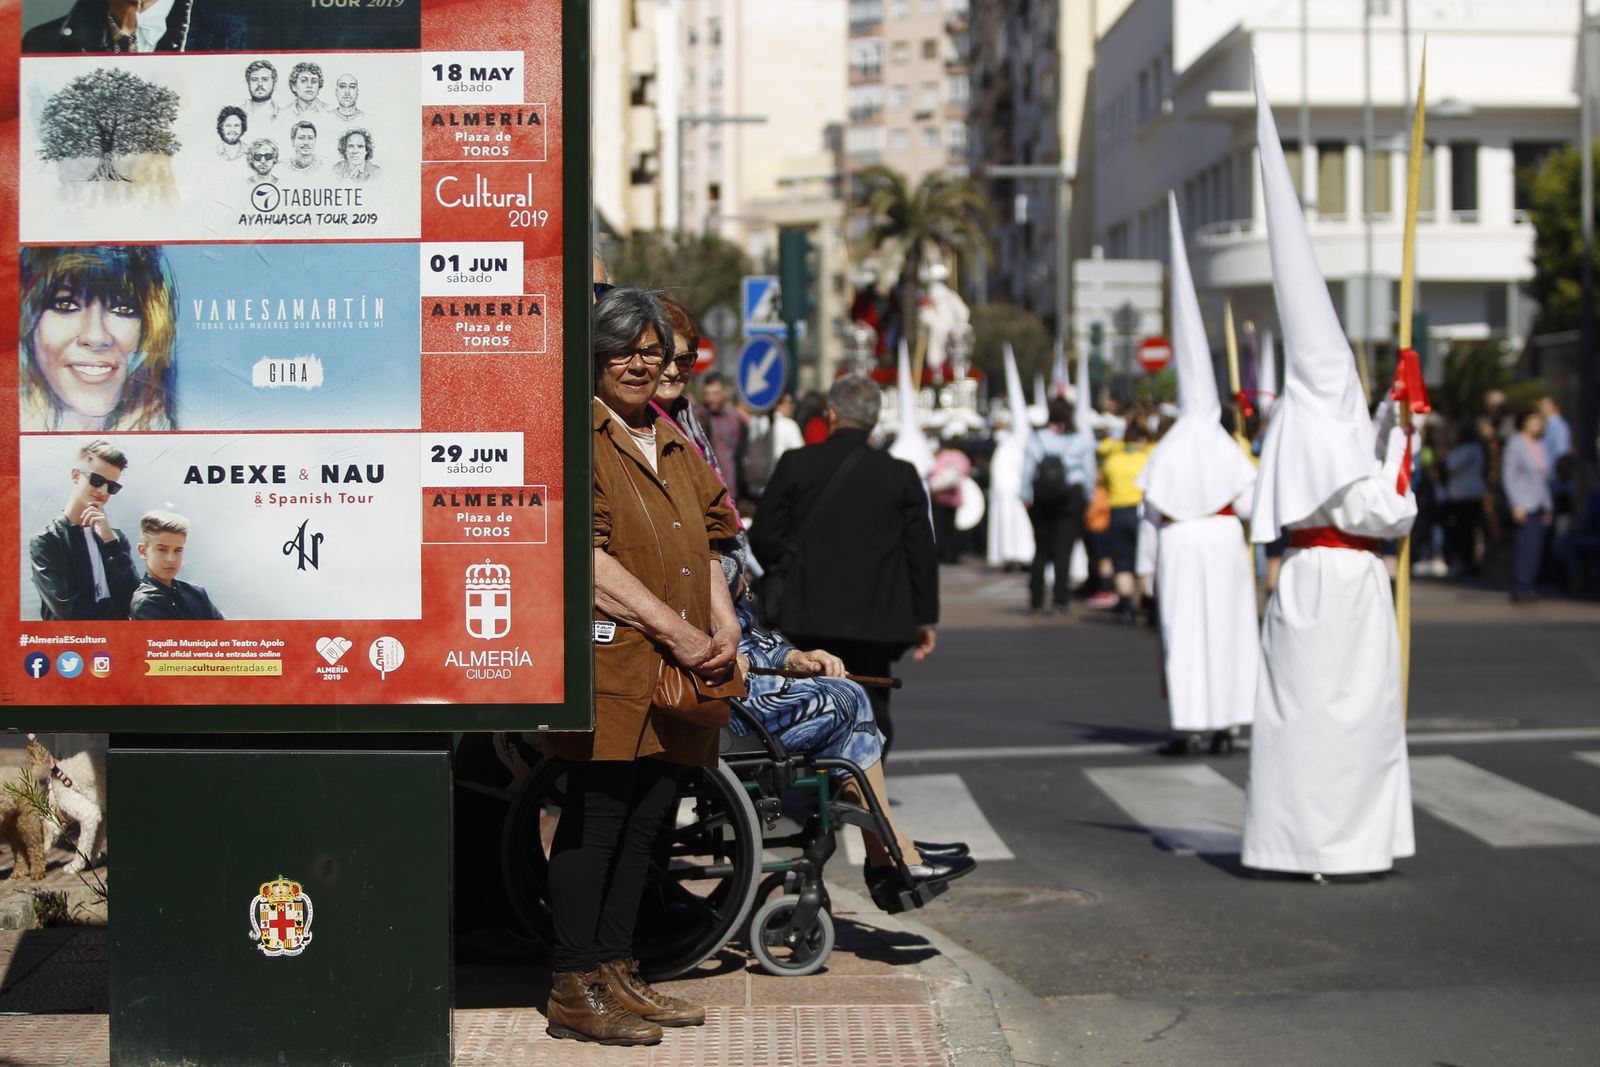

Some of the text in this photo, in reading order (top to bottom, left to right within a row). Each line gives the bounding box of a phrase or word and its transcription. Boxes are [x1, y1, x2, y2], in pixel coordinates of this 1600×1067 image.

[432, 64, 514, 82] 18 MAY
[447, 82, 493, 92] sábado
[431, 109, 541, 126] ALMERÍA
[455, 132, 512, 142] Plaza de
[463, 146, 509, 156] TOROS
[282, 188, 363, 206] TABURETE
[436, 173, 533, 208] Cultural
[238, 213, 378, 226] AYAHUASCA TOUR 2019
[508, 210, 549, 228] 2019
[430, 254, 508, 272] 01 JUN
[447, 273, 492, 283] sábado
[431, 300, 542, 317] ALMERÍA
[250, 321, 289, 329] MUJERES
[455, 322, 512, 332] Plaza de
[463, 336, 510, 347] TOROS
[269, 362, 308, 383] GIRA
[430, 444, 508, 463] 29 JUN
[184, 464, 385, 484] ADEXE & NAU
[447, 463, 493, 474] sábado
[254, 492, 374, 507] & Spanish Tour
[432, 490, 543, 507] ALMERÍA
[456, 512, 513, 523] Plaza de
[464, 527, 511, 537] TOROS
[19, 634, 107, 647] #AlmeriaEScultura
[147, 639, 178, 648] Taquilla
[179, 639, 218, 648] Municipal
[231, 639, 258, 647] Teatro
[259, 639, 285, 648] Apolo
[147, 650, 169, 658] Portal
[170, 650, 192, 658] oficial
[214, 650, 225, 658] de
[226, 650, 258, 658] entradas
[259, 650, 281, 658] online
[444, 646, 533, 667] ALMERÍA
[158, 663, 278, 673] almeriaculturaentradas.es
[466, 669, 512, 680] CIUDAD
